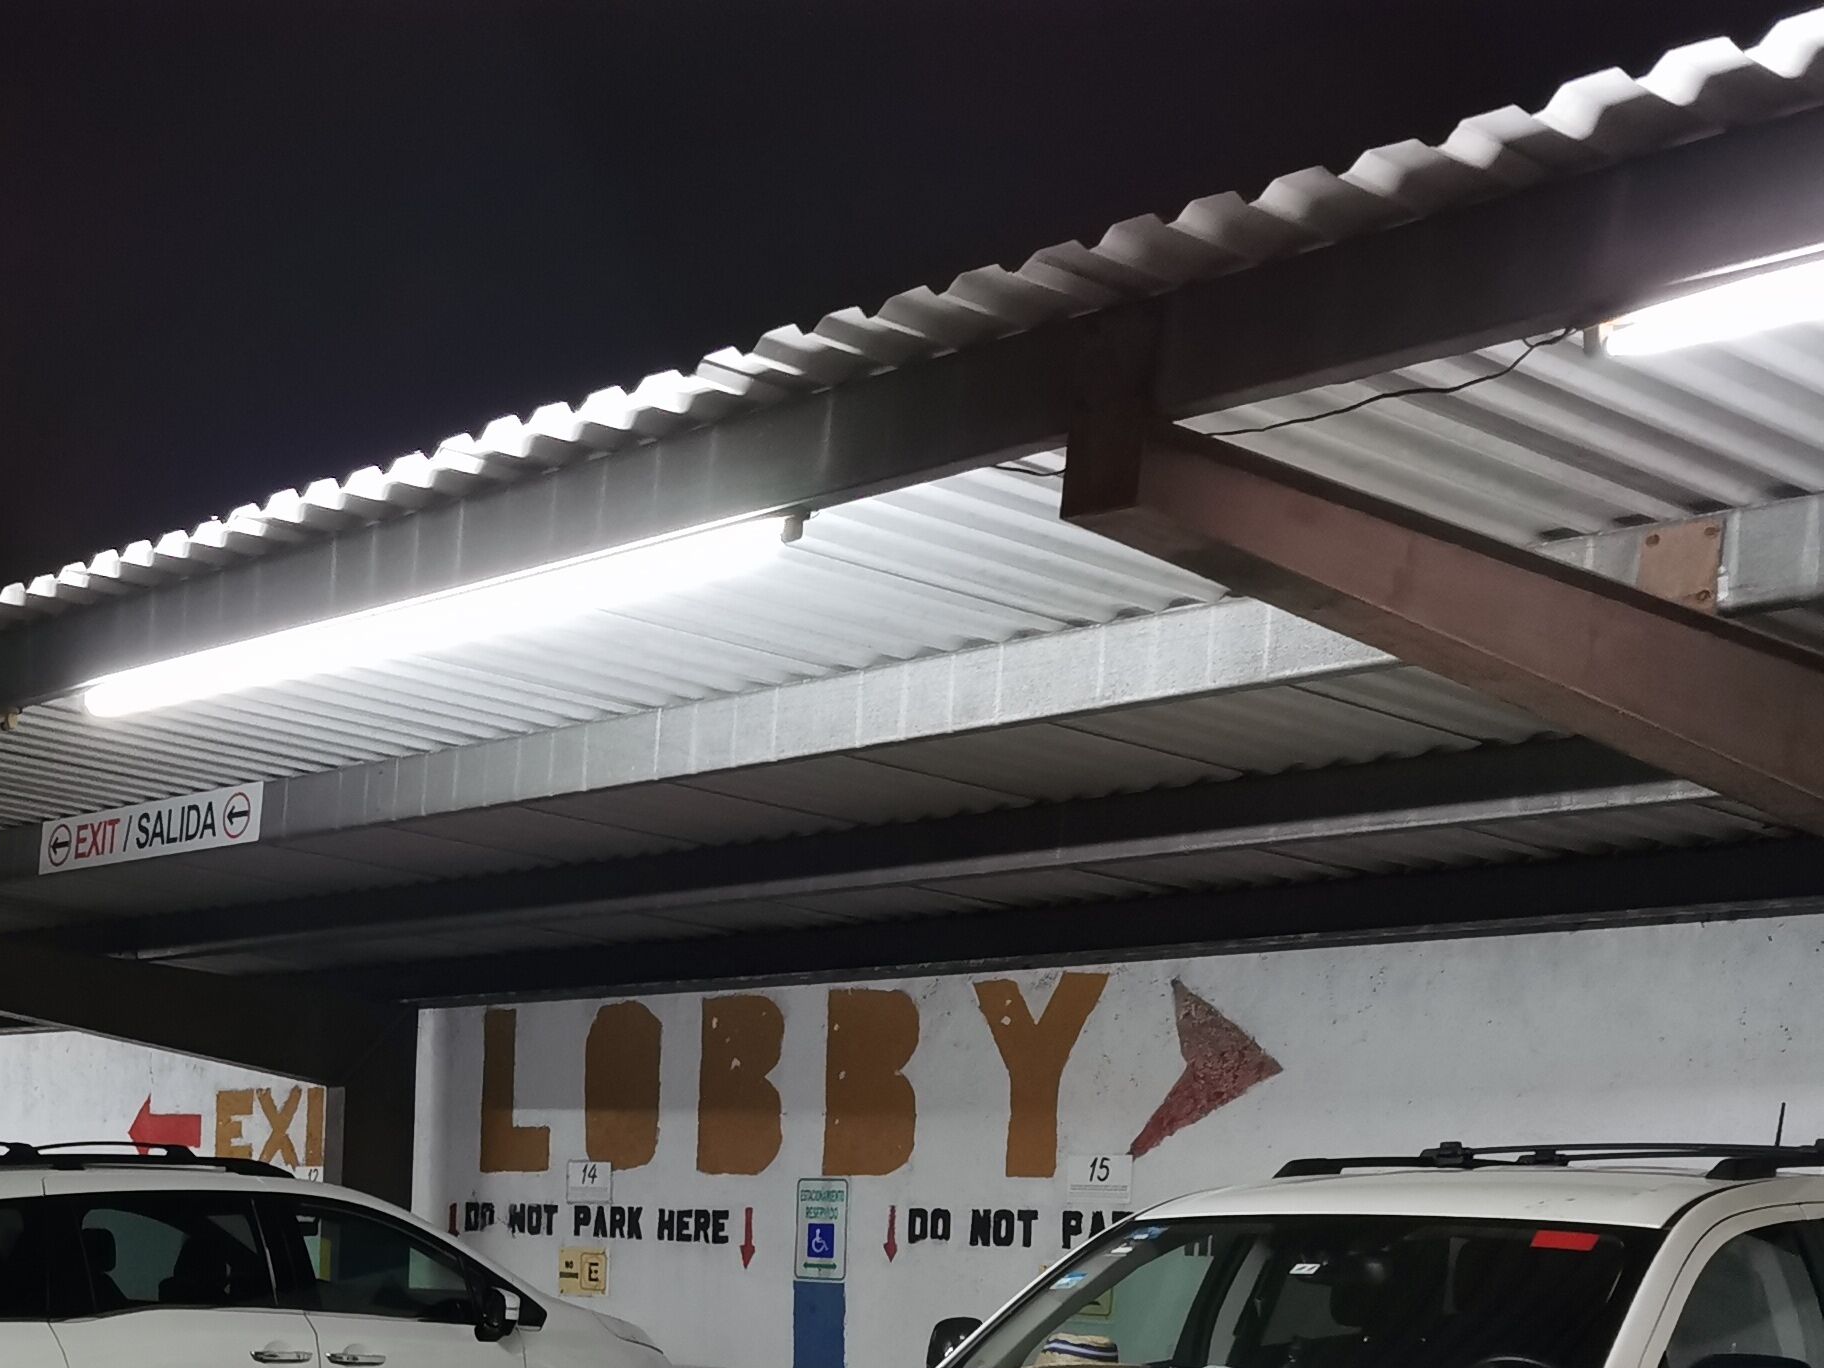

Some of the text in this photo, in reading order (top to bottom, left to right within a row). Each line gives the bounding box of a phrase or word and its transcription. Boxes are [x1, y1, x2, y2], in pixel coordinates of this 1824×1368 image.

[74, 801, 217, 860] EXIT / SALIDA
[480, 971, 1111, 1178] LOBBY
[214, 1085, 325, 1171] EXI
[581, 1163, 598, 1185] 14
[1089, 1157, 1111, 1182] 15
[464, 1202, 729, 1244] DO NOT PARK HERE
[907, 1208, 1135, 1249] DO NOT PA
[588, 1262, 599, 1282] E
